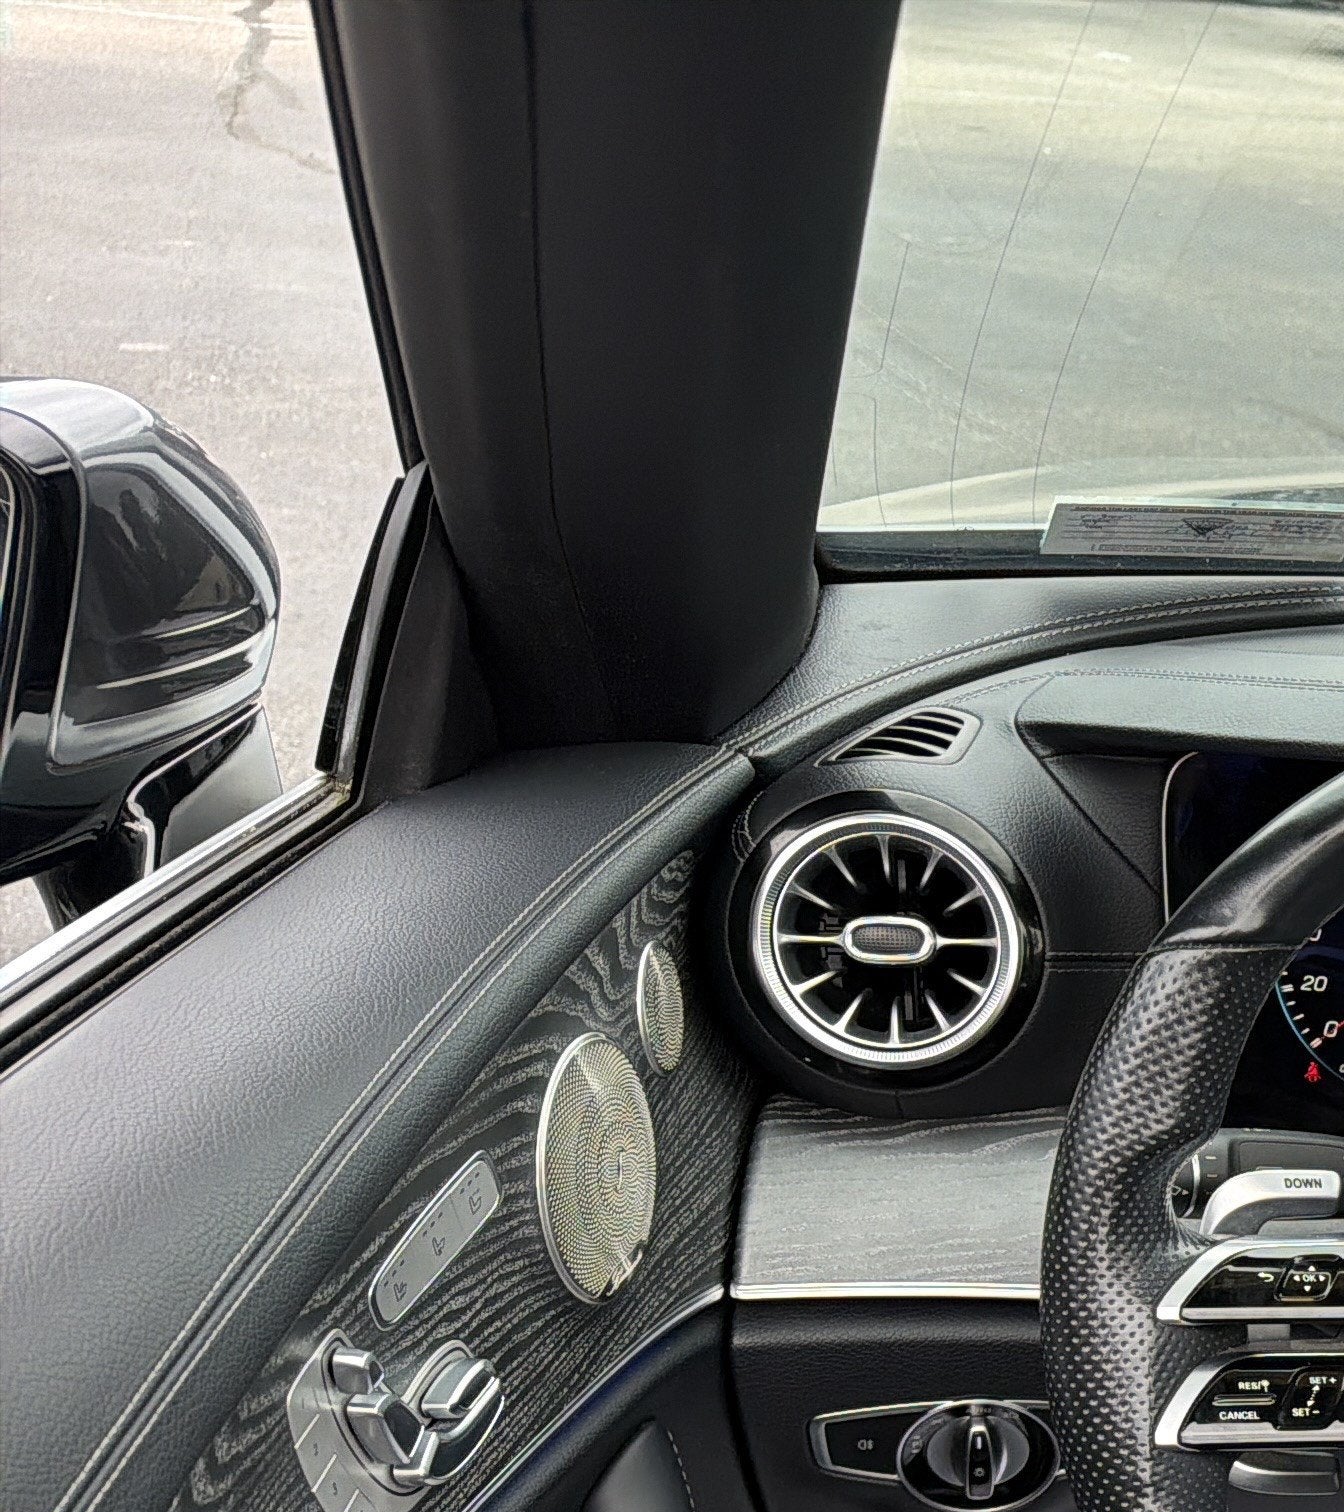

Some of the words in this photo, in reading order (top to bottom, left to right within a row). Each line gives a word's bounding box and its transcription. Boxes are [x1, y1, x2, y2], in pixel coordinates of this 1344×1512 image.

[1300, 975, 1328, 993] 20
[1323, 1020, 1340, 1038] 0
[1283, 1177, 1323, 1189] DOWN
[1302, 1273, 1317, 1283] OK
[1218, 1409, 1261, 1421] CANCEL
